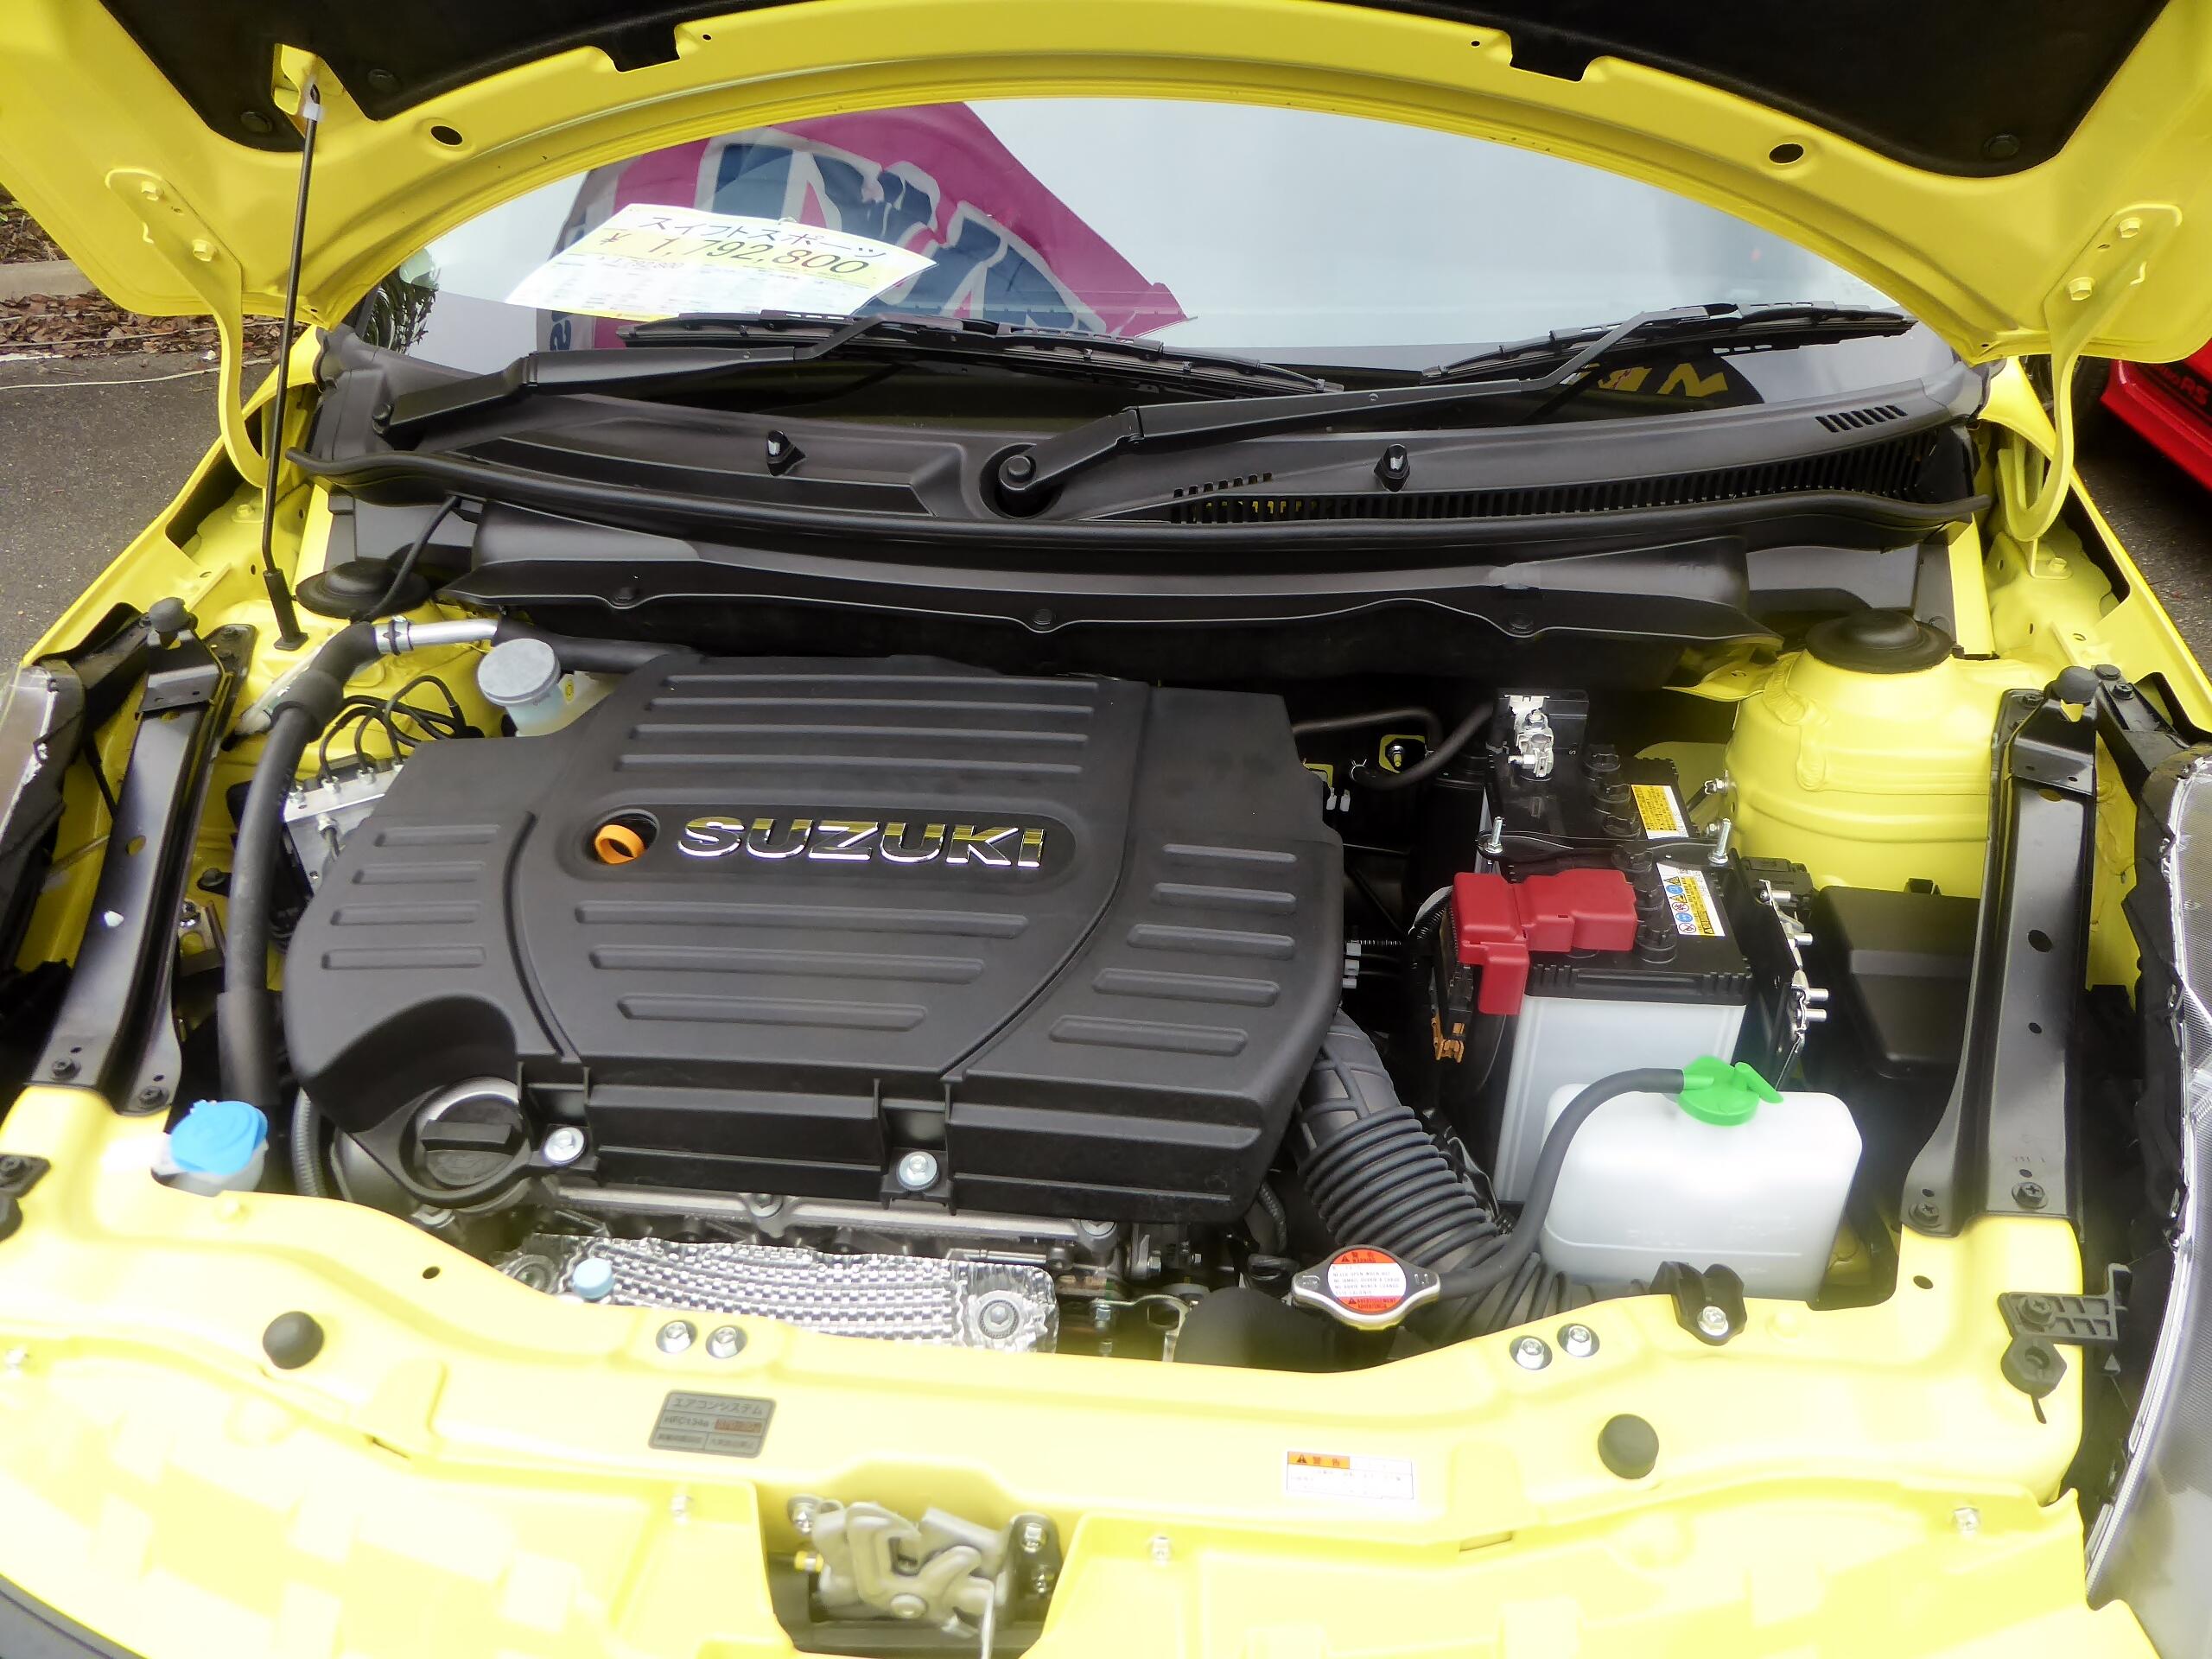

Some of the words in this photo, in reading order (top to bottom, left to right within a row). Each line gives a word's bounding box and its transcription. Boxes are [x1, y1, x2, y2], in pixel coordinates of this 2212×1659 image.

[639, 216, 887, 258] スイフトスポーツ
[648, 237, 869, 275] 1,792,800
[677, 816, 1046, 868] SUZUKI
